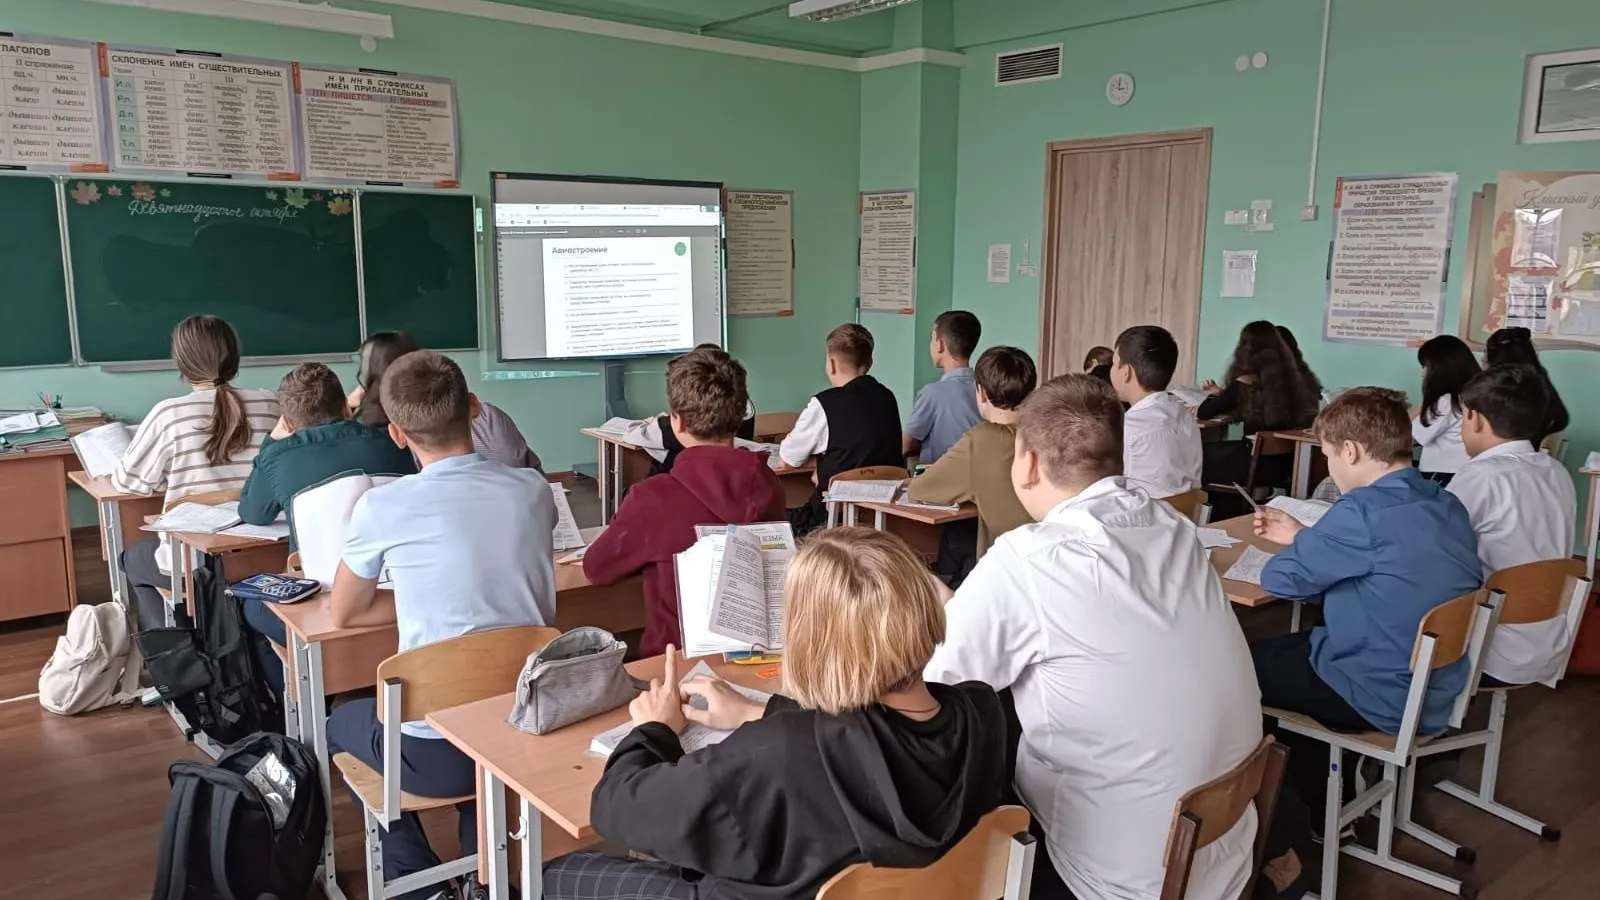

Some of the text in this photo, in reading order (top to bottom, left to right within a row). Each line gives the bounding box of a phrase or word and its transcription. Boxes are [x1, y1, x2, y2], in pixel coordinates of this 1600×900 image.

[0, 44, 51, 56] ЛАГОЛОВ
[111, 55, 165, 67] СКЛОНЕНИЕ
[198, 62, 282, 78] СУЩЕСТВИТЕЛЬНЫХ
[351, 77, 362, 85] НН
[377, 79, 425, 91] СУФФИКСАХ
[354, 84, 429, 98] ПРИЛАГАТЕЛЬНЫХ
[331, 91, 374, 101] ПИШЕТСЯ
